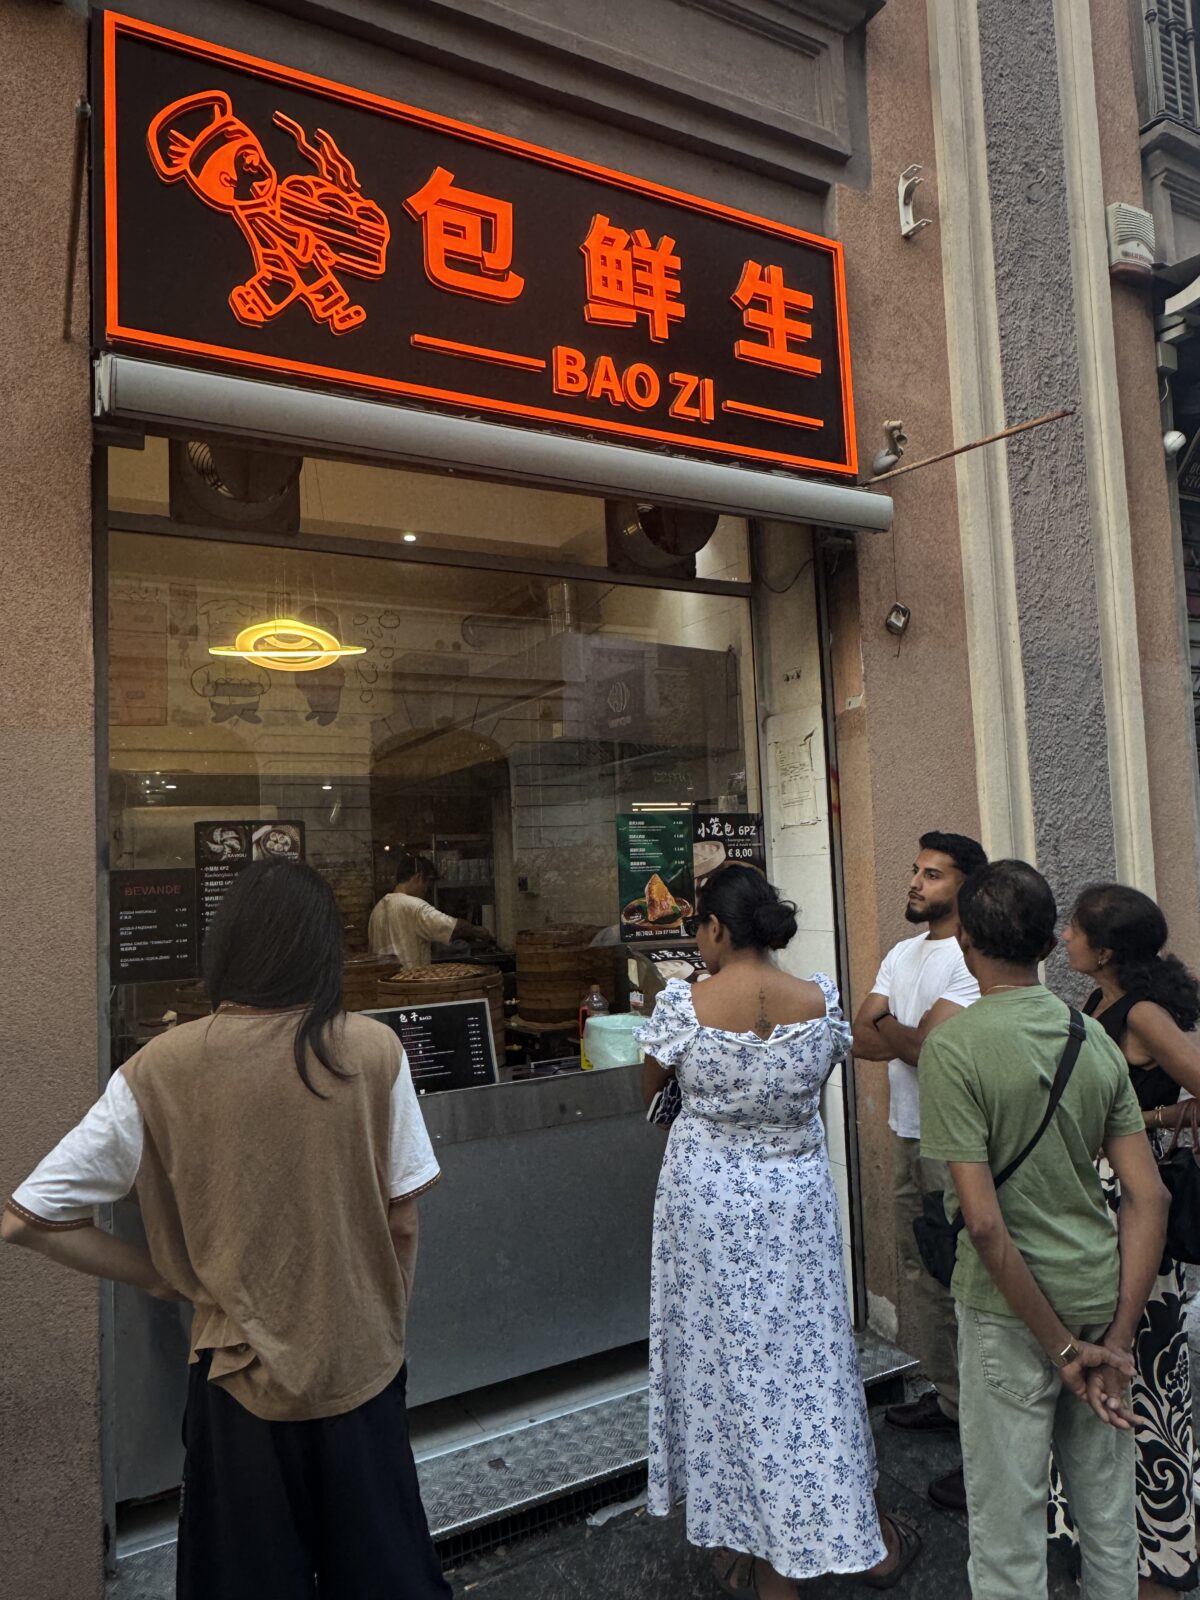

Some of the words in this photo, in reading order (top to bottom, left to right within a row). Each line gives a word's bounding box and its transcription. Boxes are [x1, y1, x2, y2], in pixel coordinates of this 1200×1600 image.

[403, 166, 823, 377] 包鲜生
[552, 345, 661, 412] BAO
[668, 371, 715, 425] ZI
[738, 825, 757, 836] 6PZ
[727, 848, 734, 858] €
[735, 848, 753, 859] 8,00
[124, 885, 181, 897] BEVANDE
